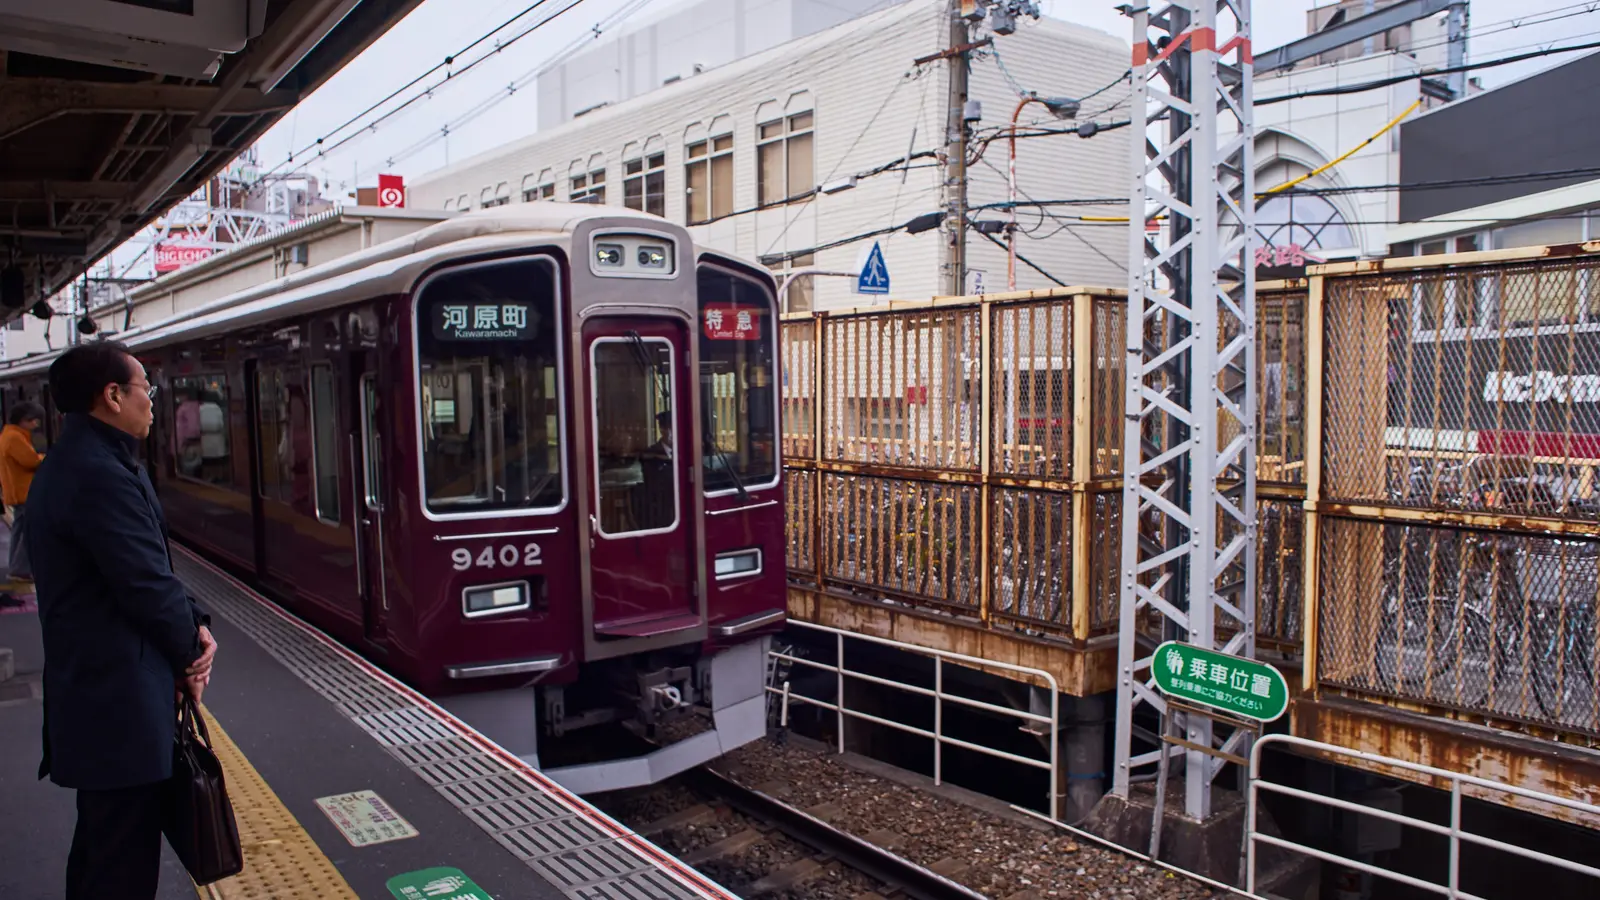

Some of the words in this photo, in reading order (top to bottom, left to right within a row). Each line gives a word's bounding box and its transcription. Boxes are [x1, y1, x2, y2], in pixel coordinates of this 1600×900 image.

[442, 304, 528, 330] 河原町
[705, 308, 753, 331] 特急
[455, 328, 518, 338] Kawaramachi
[451, 542, 543, 571] 9402
[1188, 657, 1272, 699] 乗車位置
[1170, 677, 1263, 711] 整列乗車にご協力ください
